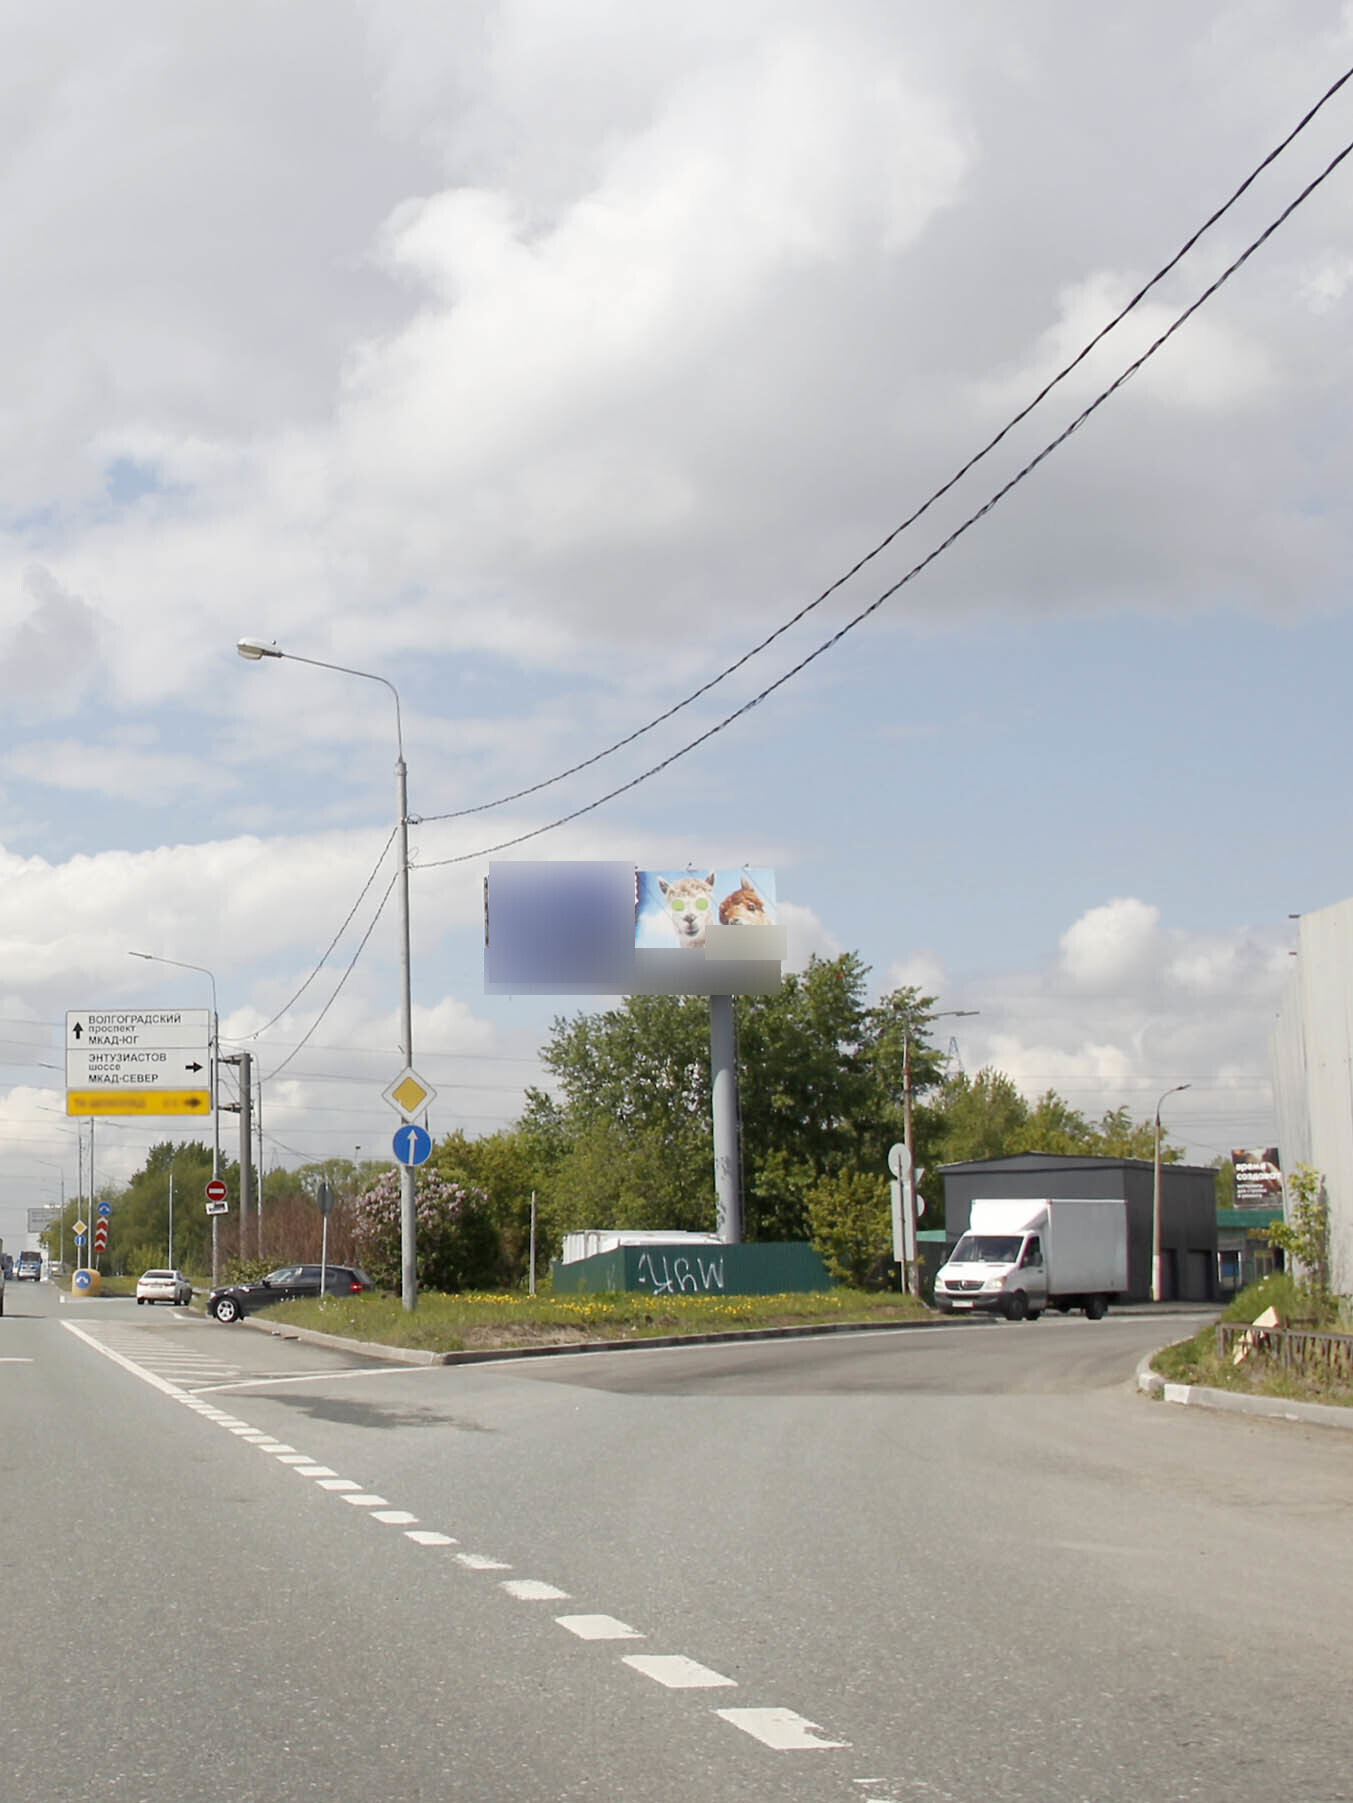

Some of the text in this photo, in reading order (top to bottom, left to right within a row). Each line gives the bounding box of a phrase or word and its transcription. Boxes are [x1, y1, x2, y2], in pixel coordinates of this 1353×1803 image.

[88, 1013, 182, 1024] ВОЛГОГРАДСКИЙ
[88, 1025, 136, 1034] проспект
[88, 1035, 139, 1045] МКАД-ЮГ
[88, 1053, 167, 1062] ЭНТУЗИАСТОВ
[88, 1074, 159, 1084] МКАД-СЕВЕР
